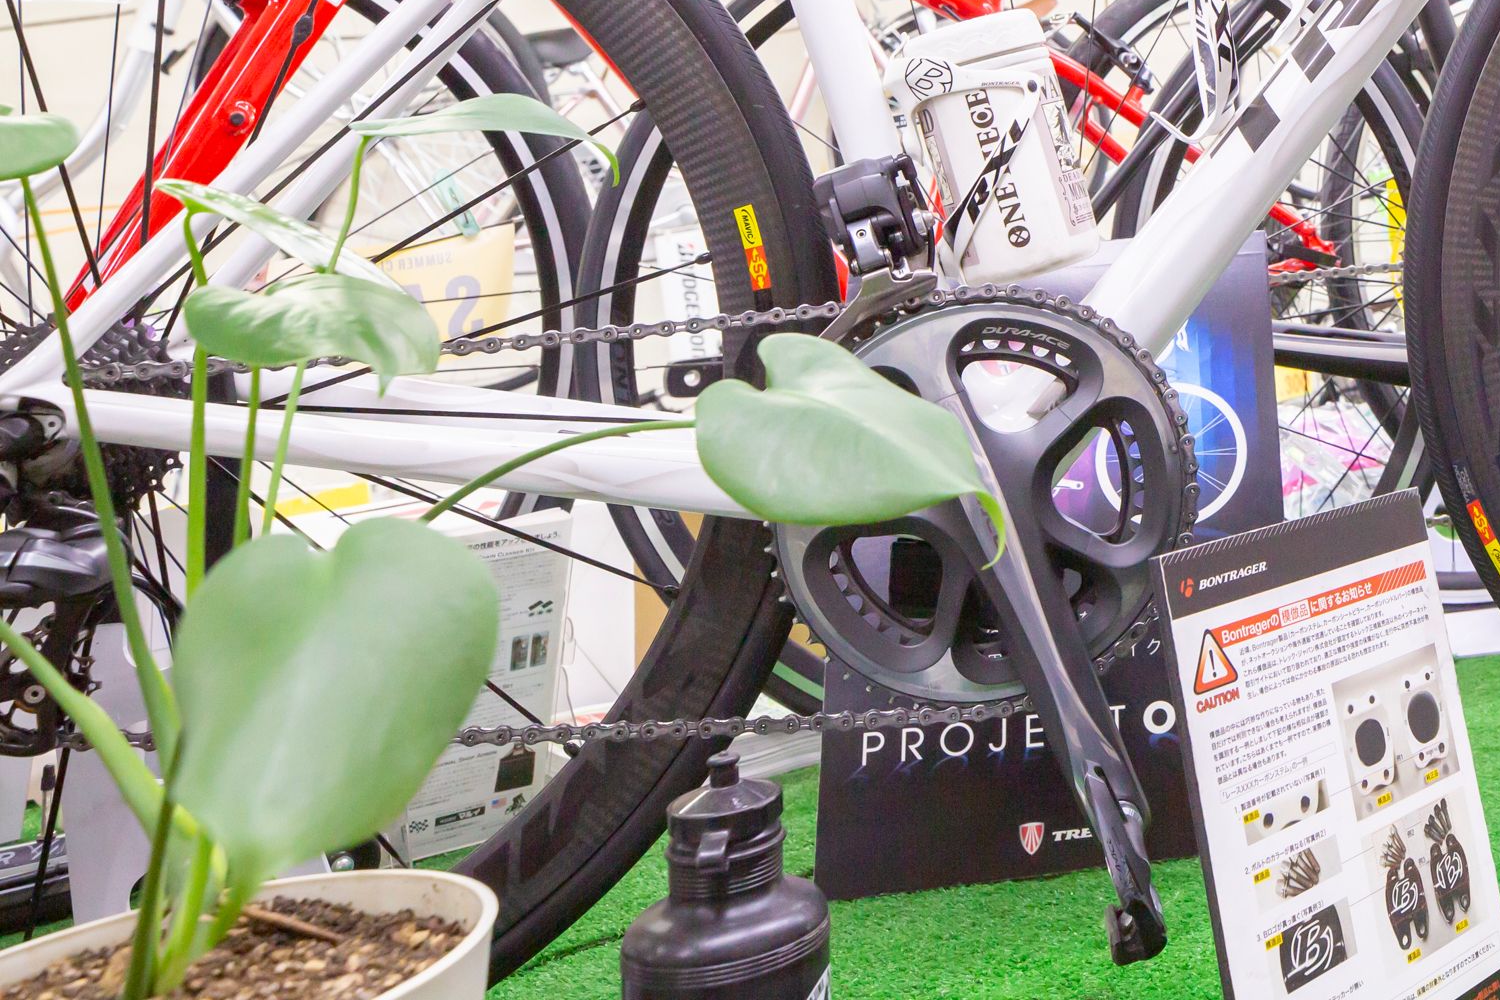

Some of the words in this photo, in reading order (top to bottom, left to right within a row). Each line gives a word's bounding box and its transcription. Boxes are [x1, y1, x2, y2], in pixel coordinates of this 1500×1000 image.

[741, 214, 754, 239] MAVIC
[751, 253, 765, 286] SSC
[981, 326, 1071, 351] DURA-ACE
[1198, 560, 1268, 592] BONTRAGER
[1195, 686, 1240, 714] CAUTION
[861, 704, 1126, 767] PROJET
[1052, 827, 1094, 843] TRE
